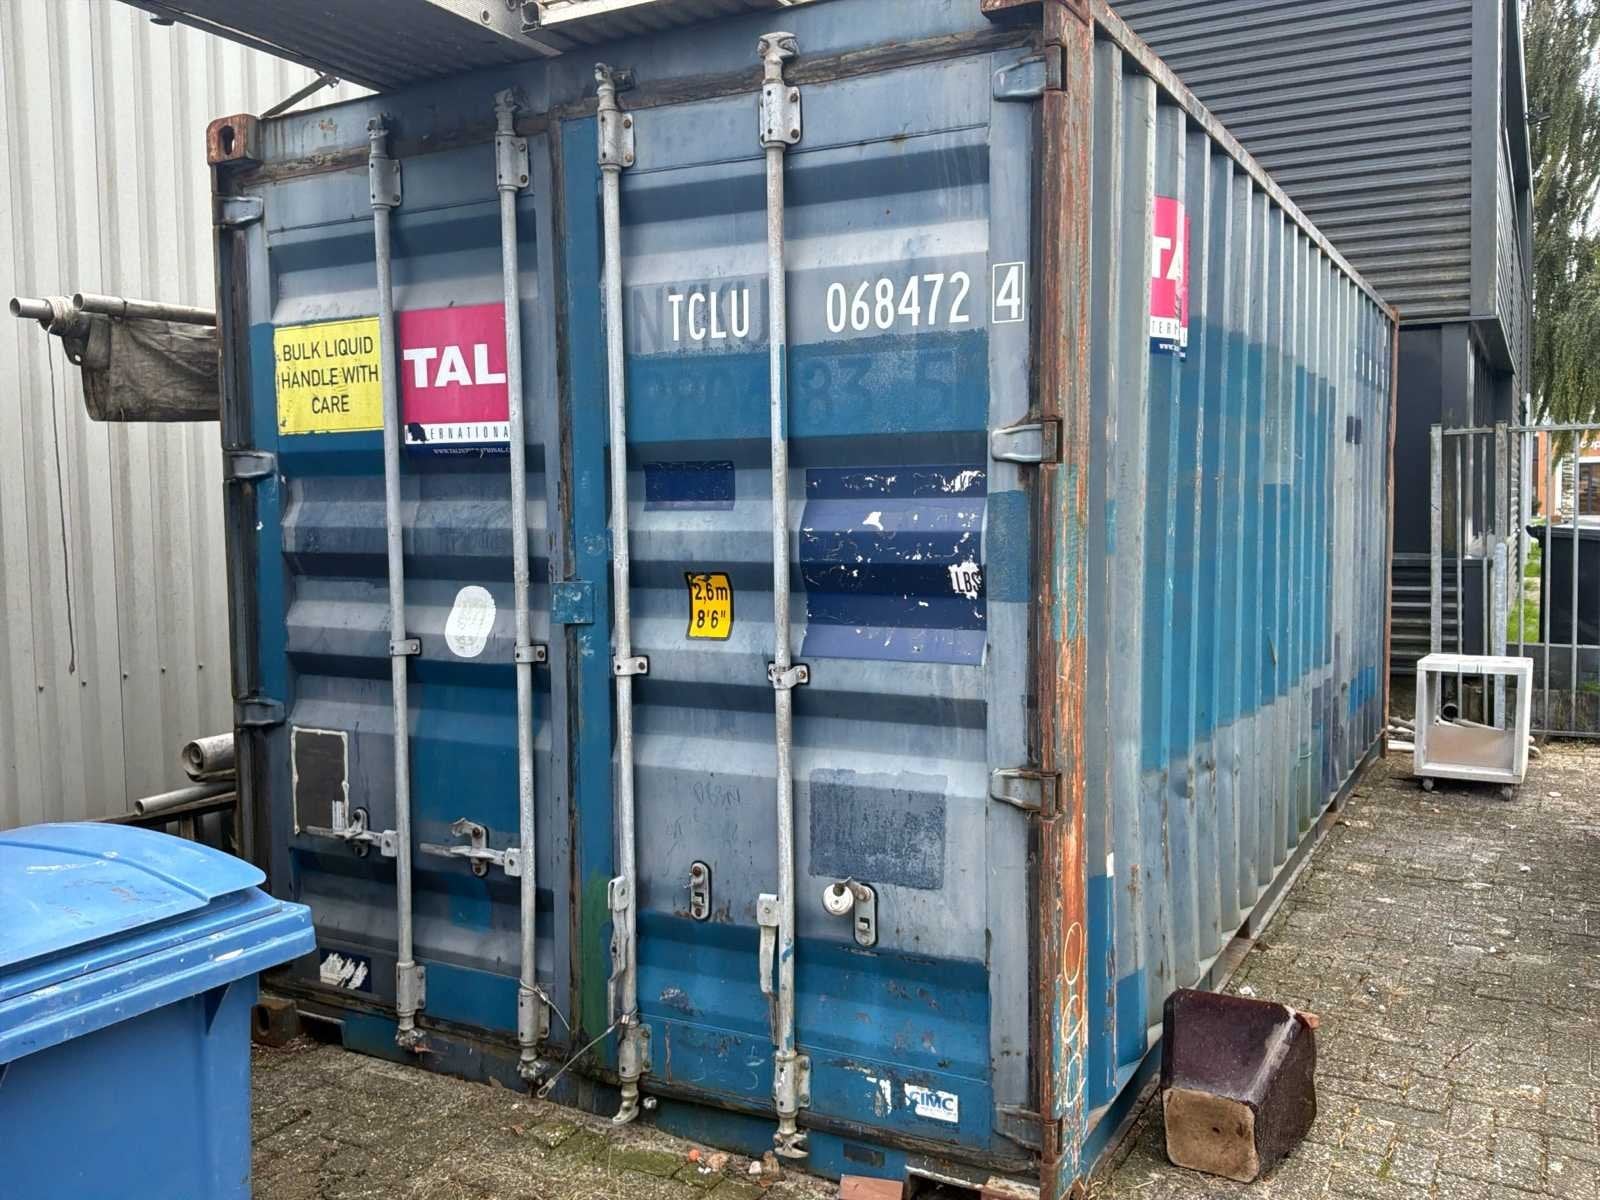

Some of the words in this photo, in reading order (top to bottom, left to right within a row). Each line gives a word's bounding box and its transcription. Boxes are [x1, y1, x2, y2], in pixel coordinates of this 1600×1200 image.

[668, 289, 749, 341] TCLU
[826, 271, 970, 333] 068472
[995, 265, 1022, 319] 4
[283, 343, 320, 362] BULK
[325, 336, 374, 357] LIQUID
[281, 366, 338, 389] HANDLE
[343, 364, 379, 385] WITH
[404, 344, 506, 388] TAL
[311, 394, 351, 414] CARE
[955, 571, 981, 593] LBS
